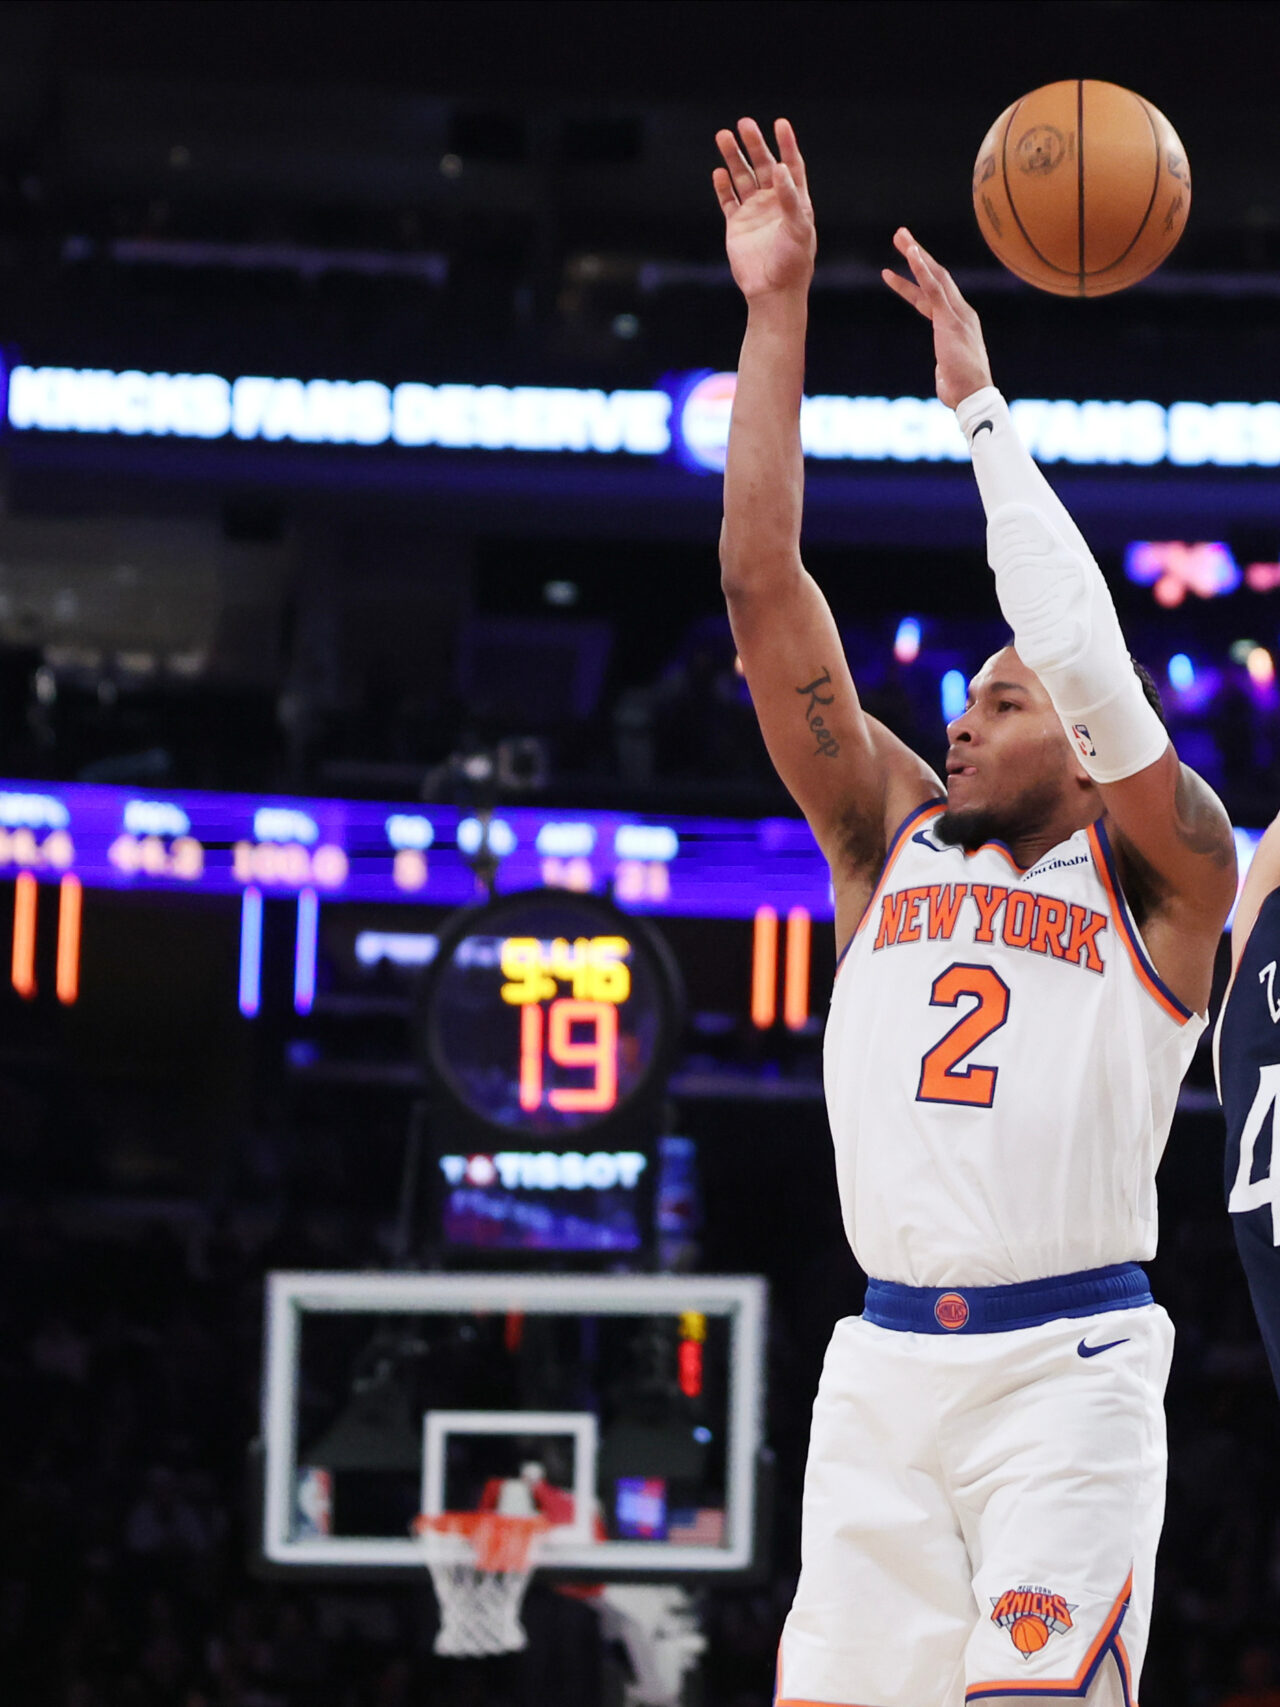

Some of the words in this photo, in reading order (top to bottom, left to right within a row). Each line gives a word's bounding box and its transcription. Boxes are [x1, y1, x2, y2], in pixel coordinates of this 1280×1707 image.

[500, 936, 631, 1005] 9:46
[873, 883, 967, 953] NEW
[972, 884, 1108, 976] YORK
[518, 998, 619, 1113] 19
[915, 961, 1011, 1108] 2
[990, 1589, 1073, 1629] KNICKS
